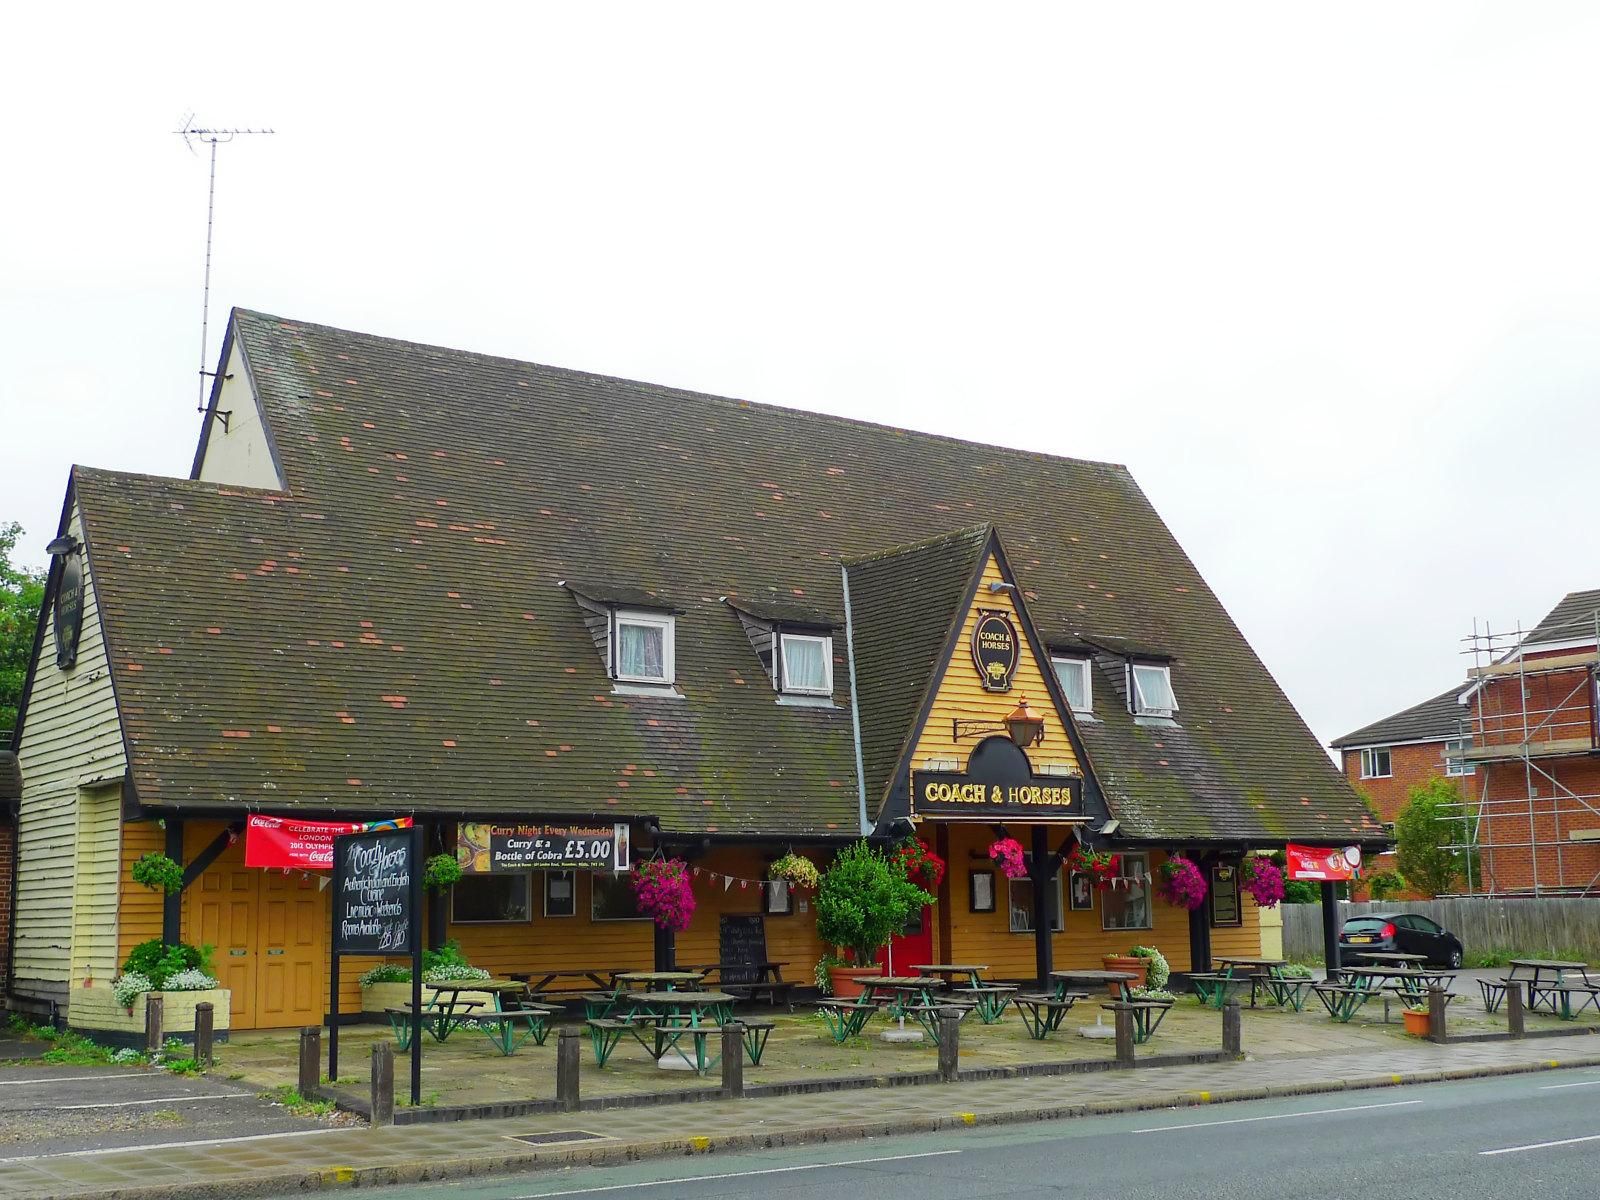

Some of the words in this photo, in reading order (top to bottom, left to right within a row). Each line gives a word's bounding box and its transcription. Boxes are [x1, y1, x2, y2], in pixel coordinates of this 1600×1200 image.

[981, 632, 1004, 641] COACH
[982, 641, 1010, 651] HORSES
[925, 782, 986, 803] COACH
[991, 785, 1003, 804] &
[1008, 786, 1071, 805] HORSES
[299, 834, 332, 842] LONDON
[491, 825, 515, 837] Curry
[518, 825, 541, 838] Night
[544, 825, 567, 837] Every
[569, 826, 614, 837] Wednesday
[507, 839, 534, 849] Curry
[535, 840, 543, 848] &
[565, 840, 611, 859] £5.00
[354, 840, 381, 874] Coach
[495, 851, 523, 861] Bottle
[525, 851, 535, 860] of
[537, 851, 562, 860] Cobra
[391, 872, 410, 891] English
[346, 902, 359, 918] Live
[358, 905, 373, 918] music
[342, 920, 360, 940] Rooms
